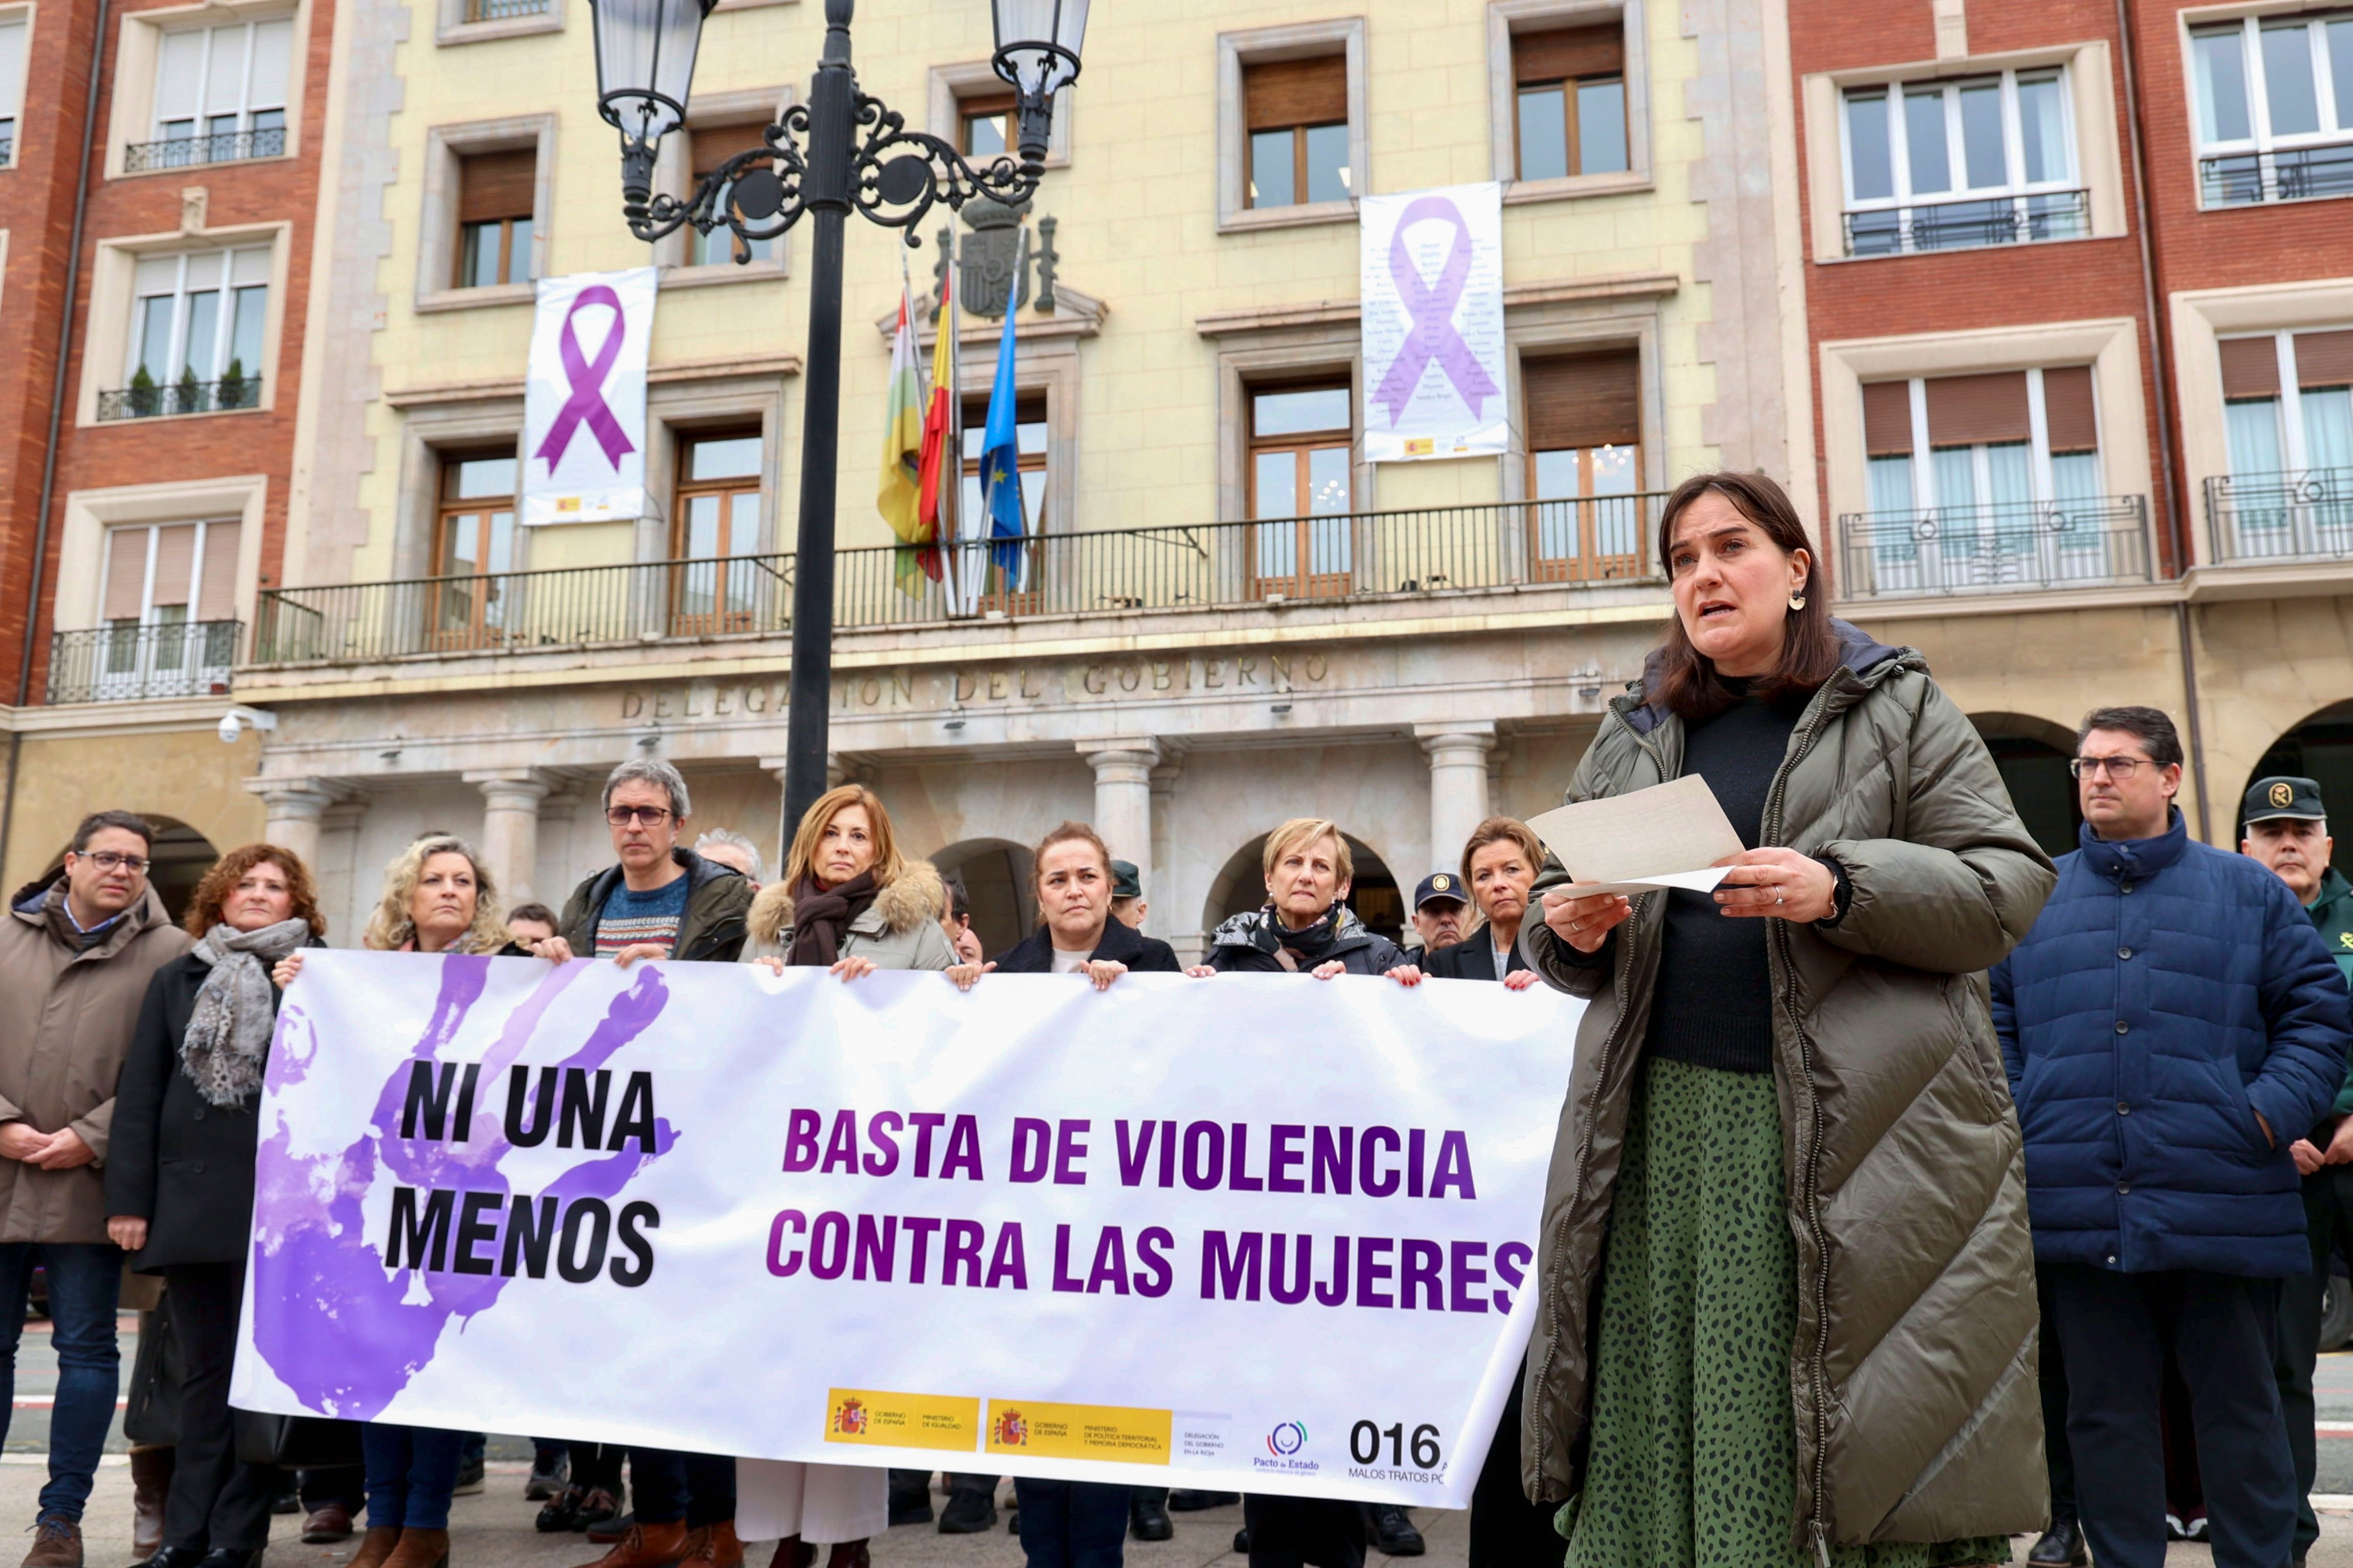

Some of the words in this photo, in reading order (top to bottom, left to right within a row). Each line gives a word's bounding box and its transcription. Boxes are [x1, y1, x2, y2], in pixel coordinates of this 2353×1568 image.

[955, 670, 1040, 702] DEL
[1083, 654, 1328, 695] GOBIERNO
[400, 1060, 481, 1142] NI
[504, 1065, 656, 1154] UNA
[782, 1108, 984, 1181] BASTA
[1009, 1117, 1091, 1185] DE
[1114, 1120, 1477, 1199] VIOLENCIA
[385, 1187, 660, 1287] MENOS
[766, 1209, 1028, 1290] CONTRA
[1052, 1224, 1175, 1298] LAS
[1200, 1230, 1534, 1315] MUJERES
[1093, 1432, 1120, 1440] POLÍTICA
[1121, 1434, 1157, 1443] TERRITORIAL
[1117, 1441, 1162, 1450] DEMOCRÁTICA
[1350, 1420, 1440, 1469] 016
[1254, 1457, 1278, 1467] Pacto
[1288, 1459, 1319, 1470] Estado
[1349, 1468, 1385, 1480] MALOS
[1388, 1470, 1428, 1484] TRATOS
